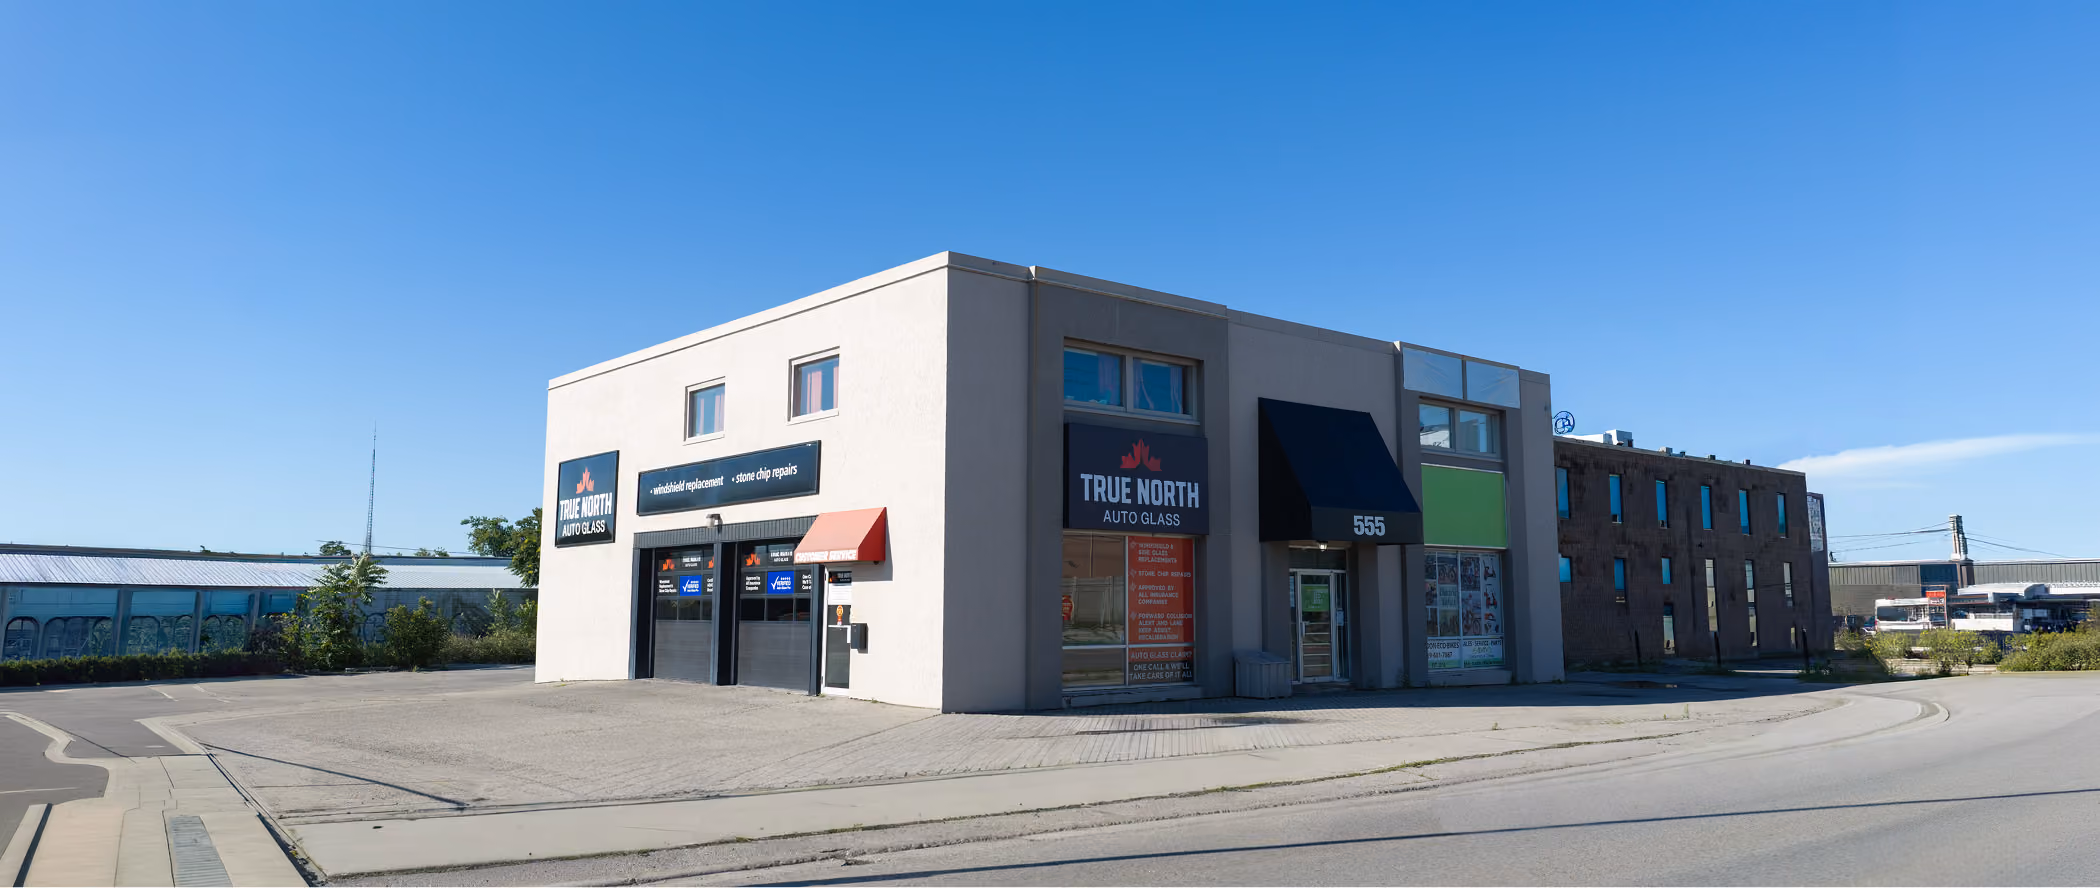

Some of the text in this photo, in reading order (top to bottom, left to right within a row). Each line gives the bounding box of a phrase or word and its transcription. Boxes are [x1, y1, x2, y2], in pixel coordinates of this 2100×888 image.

[653, 463, 798, 496] windshield replacement stone chip repairs
[1080, 474, 1200, 508] TRUE NORTH
[560, 492, 612, 520] TRUE NORTH
[1103, 510, 1180, 526] AUTO GLASS
[1354, 515, 1386, 536] 555
[562, 520, 606, 536] AUTO GLASS
[1131, 652, 1148, 660] AUTO
[1129, 672, 1146, 680] TAKE
